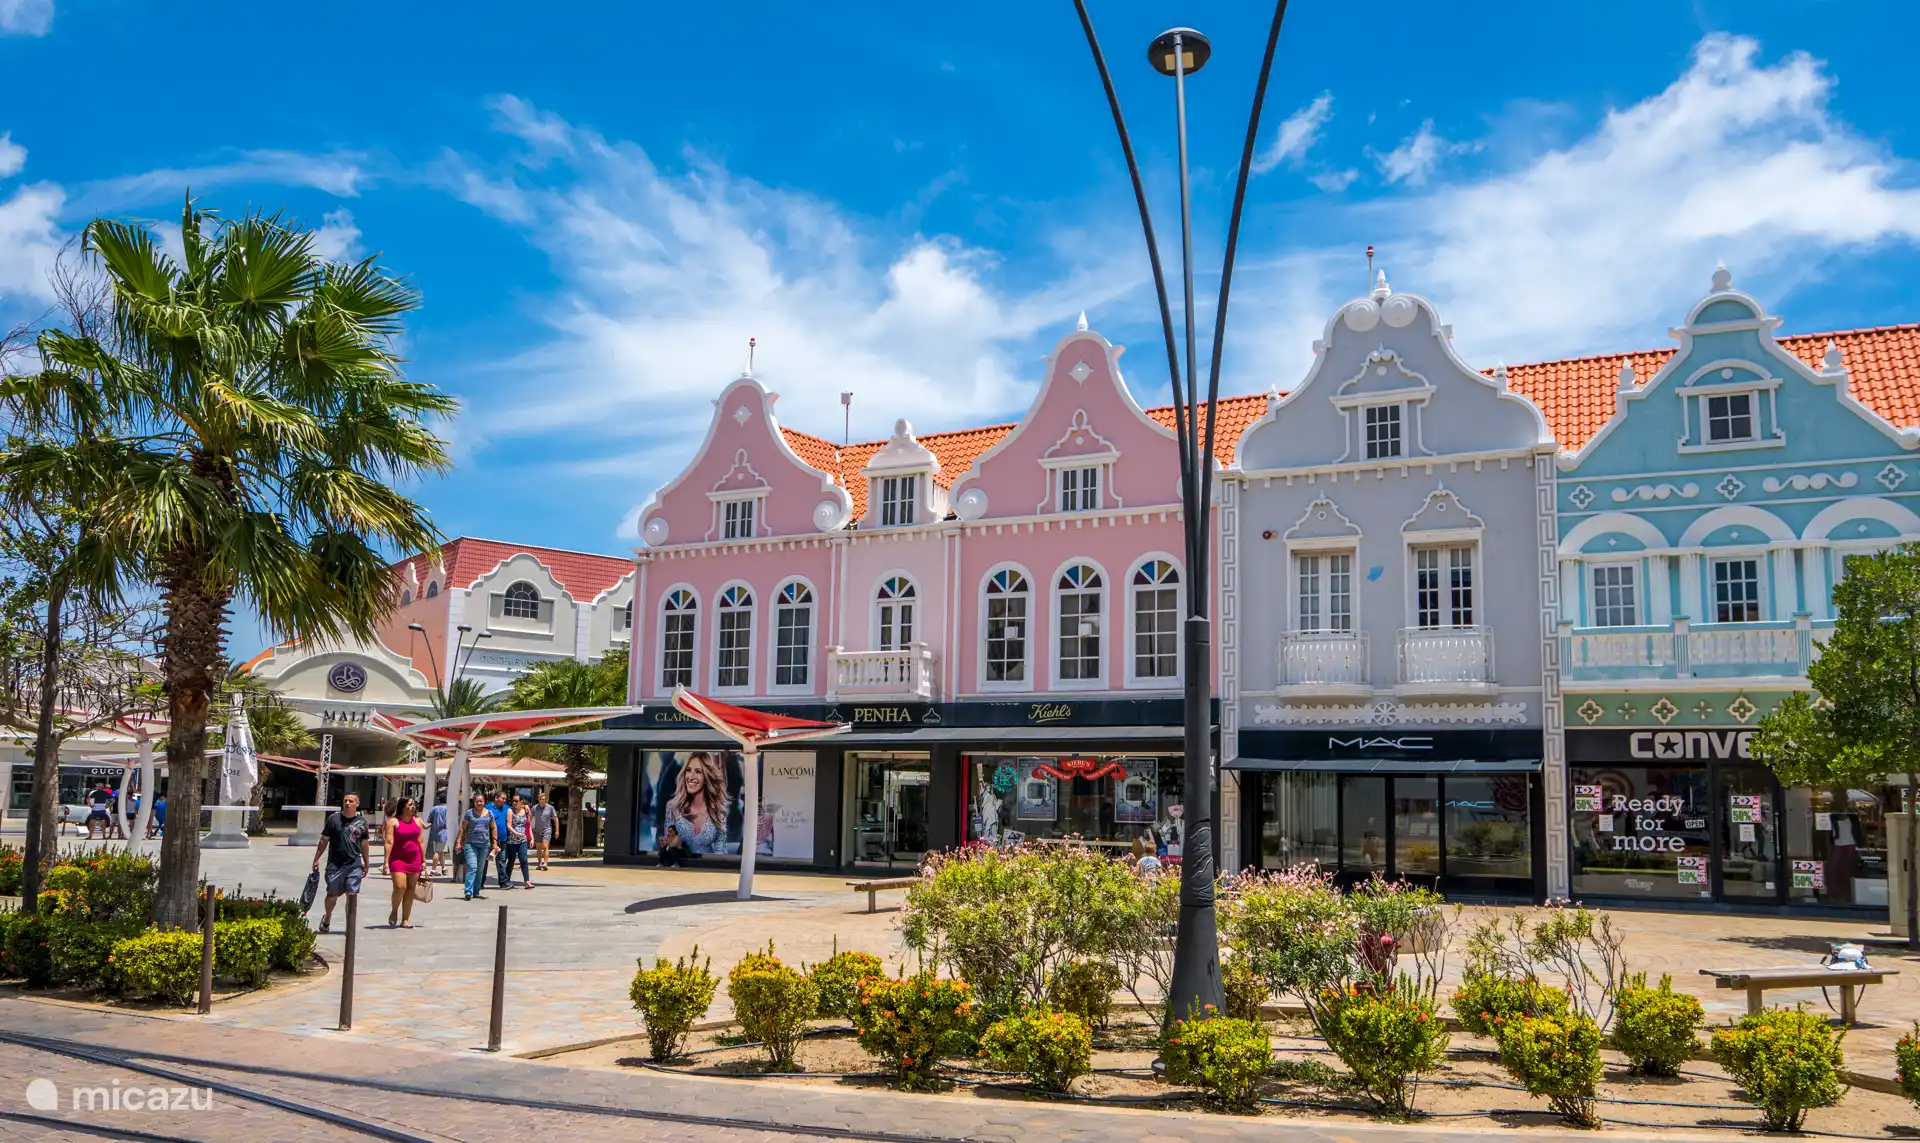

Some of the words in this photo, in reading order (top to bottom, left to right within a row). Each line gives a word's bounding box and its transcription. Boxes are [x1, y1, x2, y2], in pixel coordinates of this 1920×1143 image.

[323, 710, 369, 722] MALL
[655, 712, 693, 722] CLAR
[854, 708, 912, 722] PENHA
[1028, 704, 1071, 722] Kiehl's
[1630, 731, 1760, 759] CONVE
[1612, 795, 1684, 816] Ready
[1635, 815, 1665, 830] for
[1613, 836, 1686, 852] more
